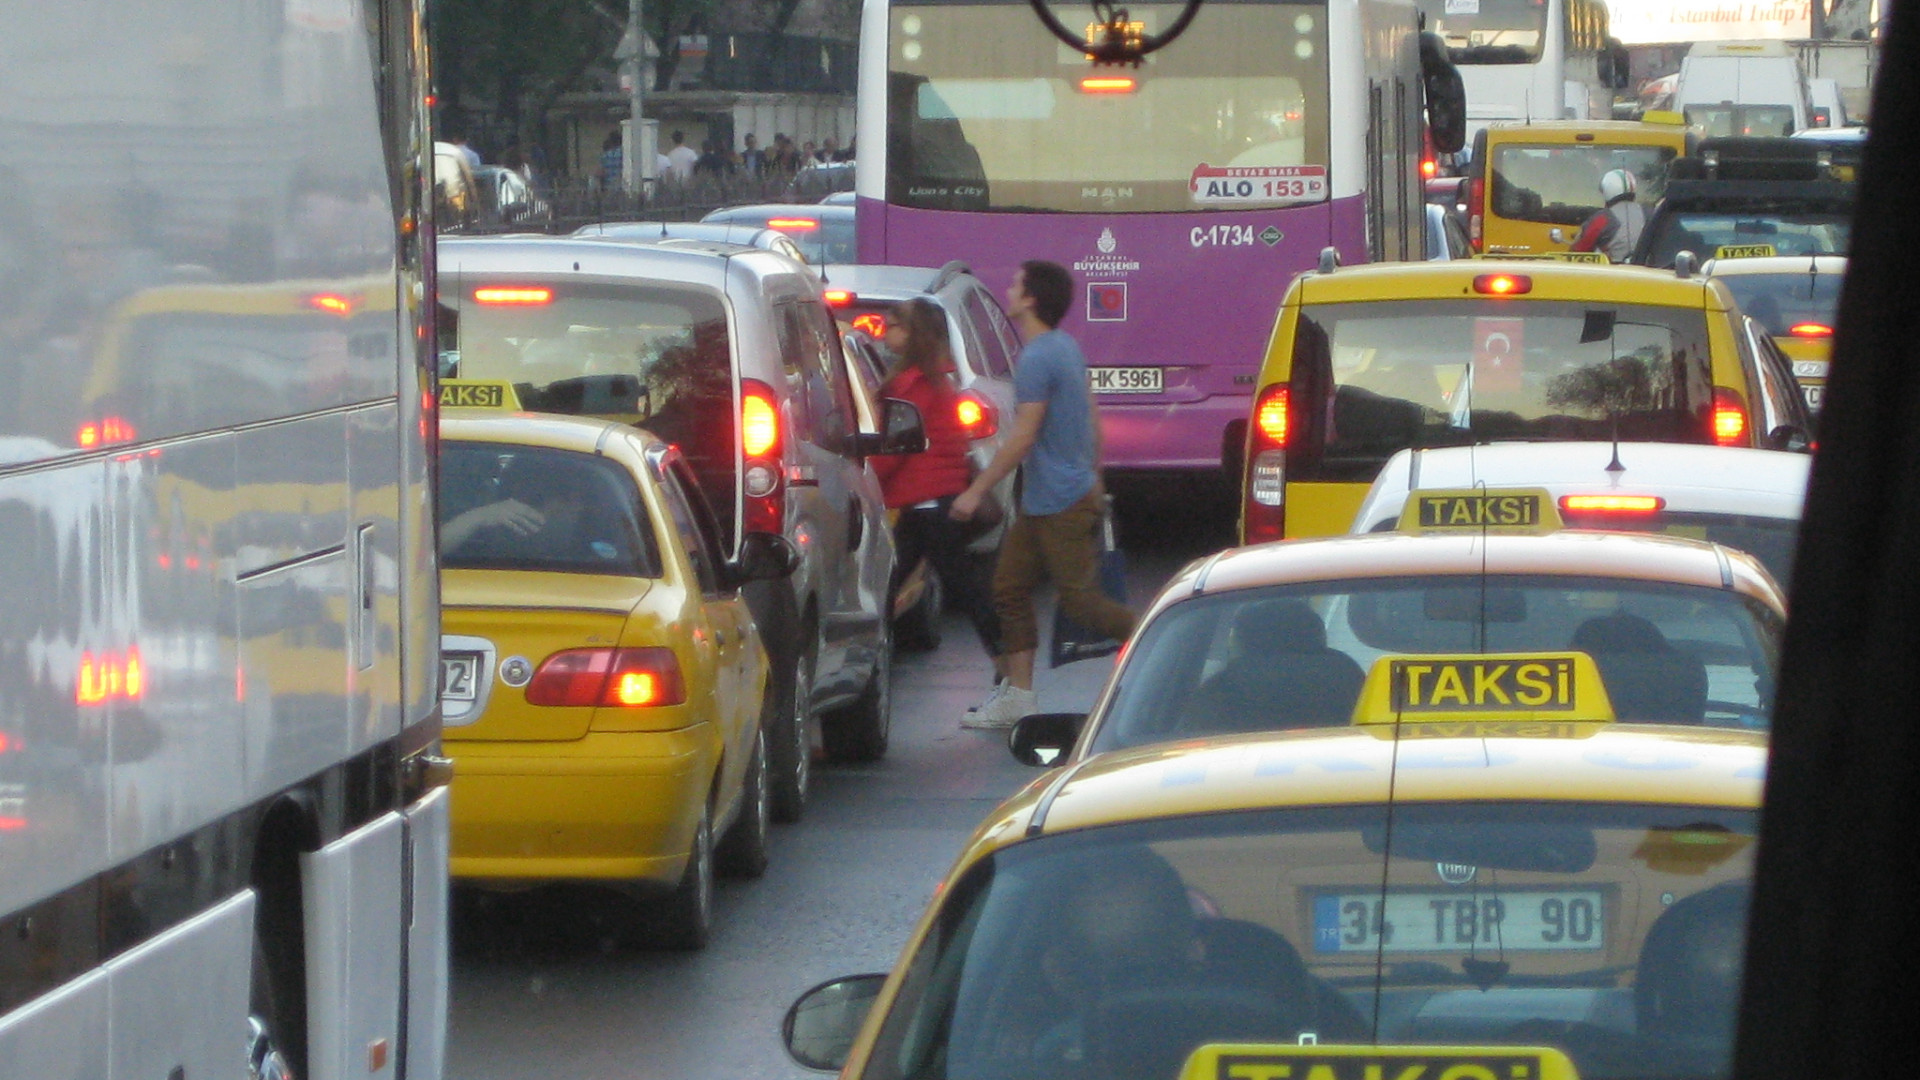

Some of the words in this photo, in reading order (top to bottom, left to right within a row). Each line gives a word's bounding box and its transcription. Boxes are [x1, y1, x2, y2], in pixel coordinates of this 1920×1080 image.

[1227, 168, 1265, 177] BEYAZ
[1269, 167, 1301, 176] MASA
[954, 185, 984, 197] City
[1082, 187, 1134, 198] MAN
[1206, 180, 1253, 197] ALO
[1263, 180, 1305, 197] 153
[1190, 224, 1255, 247] C-1734
[1119, 370, 1160, 388] 5961
[440, 386, 498, 405] AKSi
[1343, 900, 1394, 945] 34
[1429, 898, 1506, 943] TBP
[1541, 898, 1594, 943] 90
